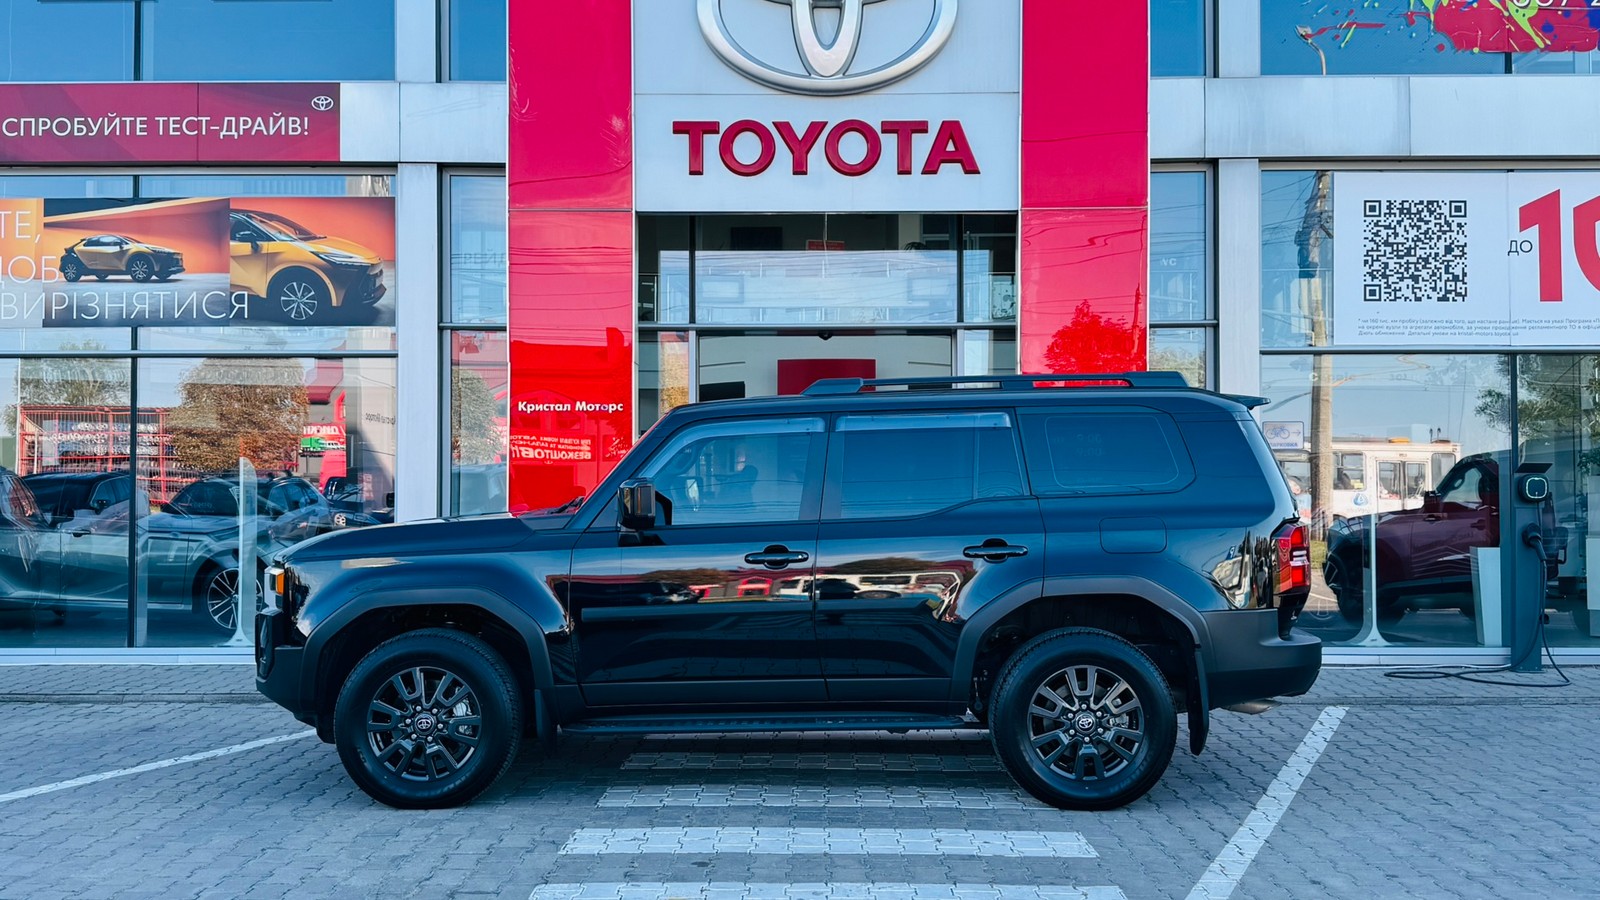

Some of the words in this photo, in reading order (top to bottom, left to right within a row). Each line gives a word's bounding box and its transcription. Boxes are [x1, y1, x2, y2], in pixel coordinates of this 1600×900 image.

[1, 112, 148, 137] СПРОБУЙТЕ
[156, 112, 310, 140] ТЕСТ-ДРАЙВ!
[672, 119, 981, 177] TOYOTA
[1507, 239, 1533, 256] ДО
[0, 255, 60, 289] ОБ
[1, 291, 249, 320] ВИРІЗНЯТИСЯ
[518, 401, 571, 414] Кристал
[575, 401, 624, 414] Моторс
